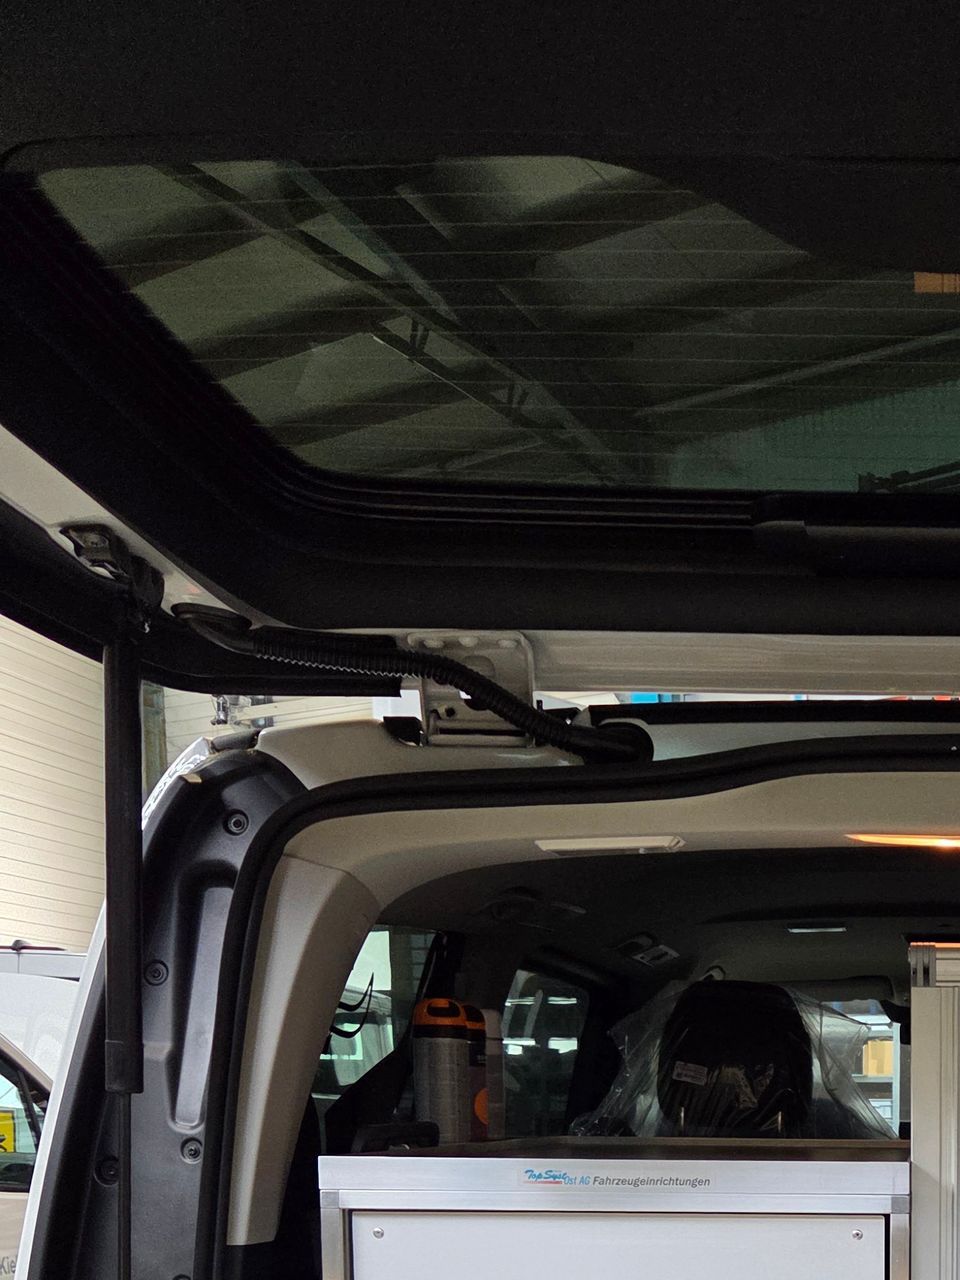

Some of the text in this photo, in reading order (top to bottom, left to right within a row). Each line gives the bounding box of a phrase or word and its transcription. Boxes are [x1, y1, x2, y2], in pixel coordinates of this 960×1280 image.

[564, 1176, 577, 1185] Ost
[578, 1176, 591, 1185] AG
[592, 1176, 711, 1189] Fahrzeugeinrichtungen
